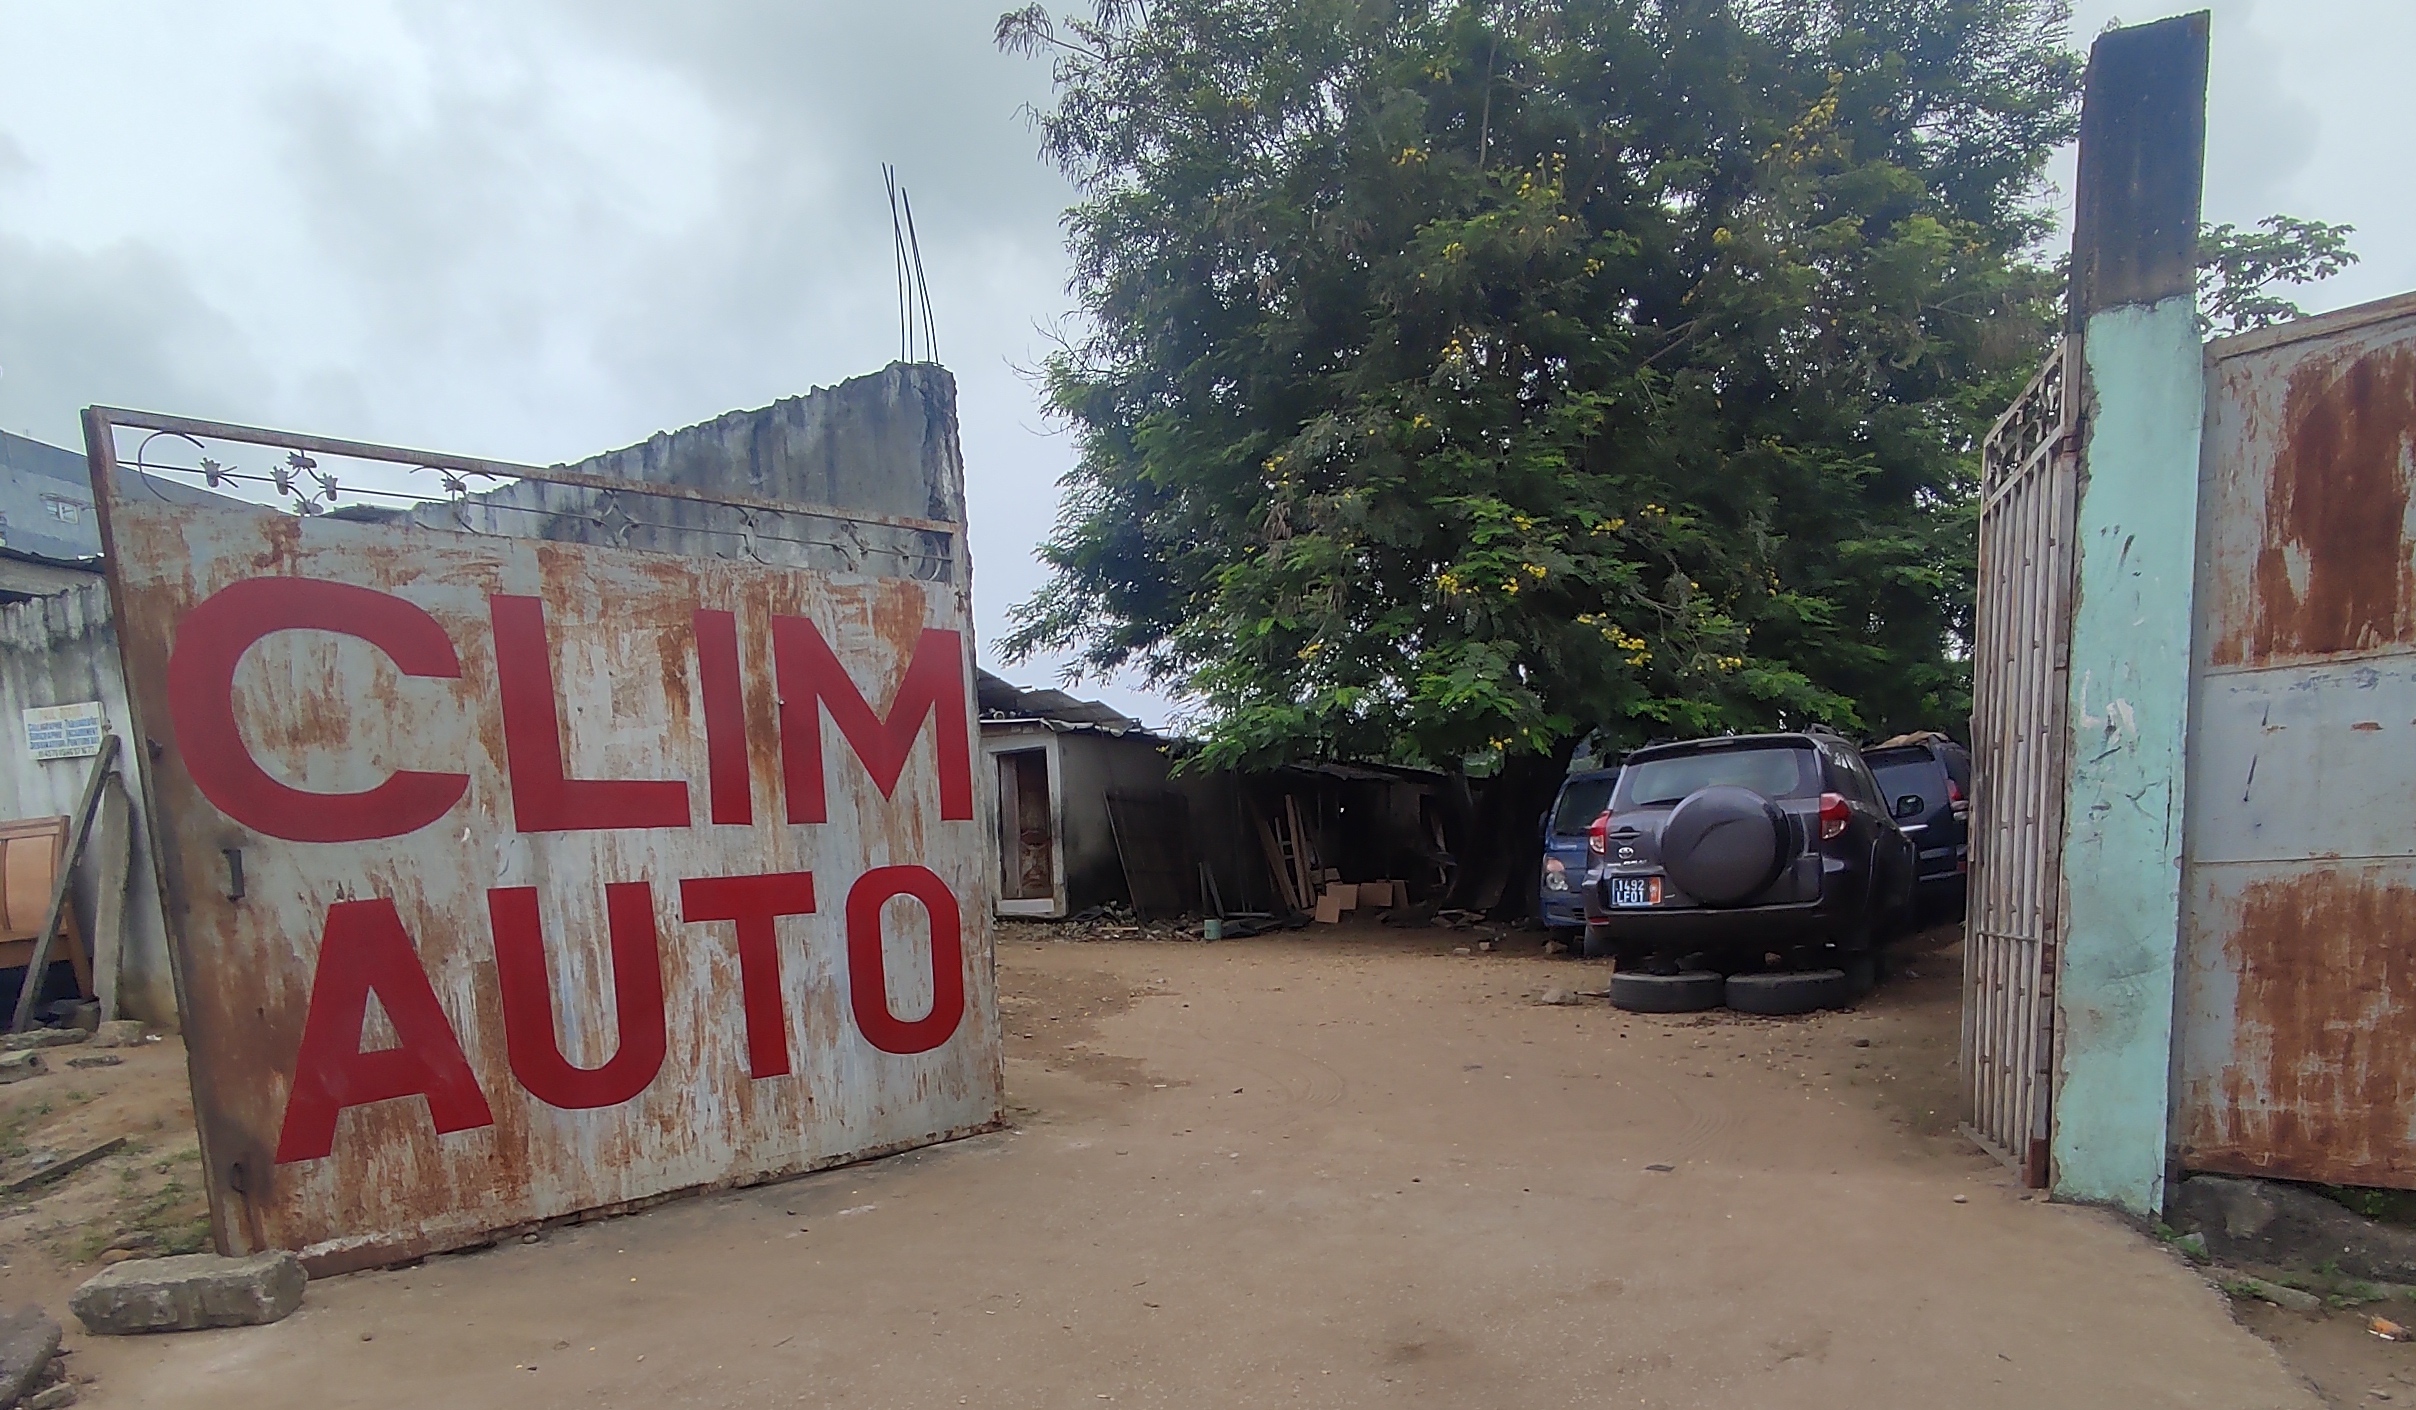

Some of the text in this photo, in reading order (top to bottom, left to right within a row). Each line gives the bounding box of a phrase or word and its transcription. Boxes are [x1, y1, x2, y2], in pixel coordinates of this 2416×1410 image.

[168, 577, 973, 842] CLIM
[276, 864, 965, 1164] AUTO
[1618, 880, 1645, 891] 1492
